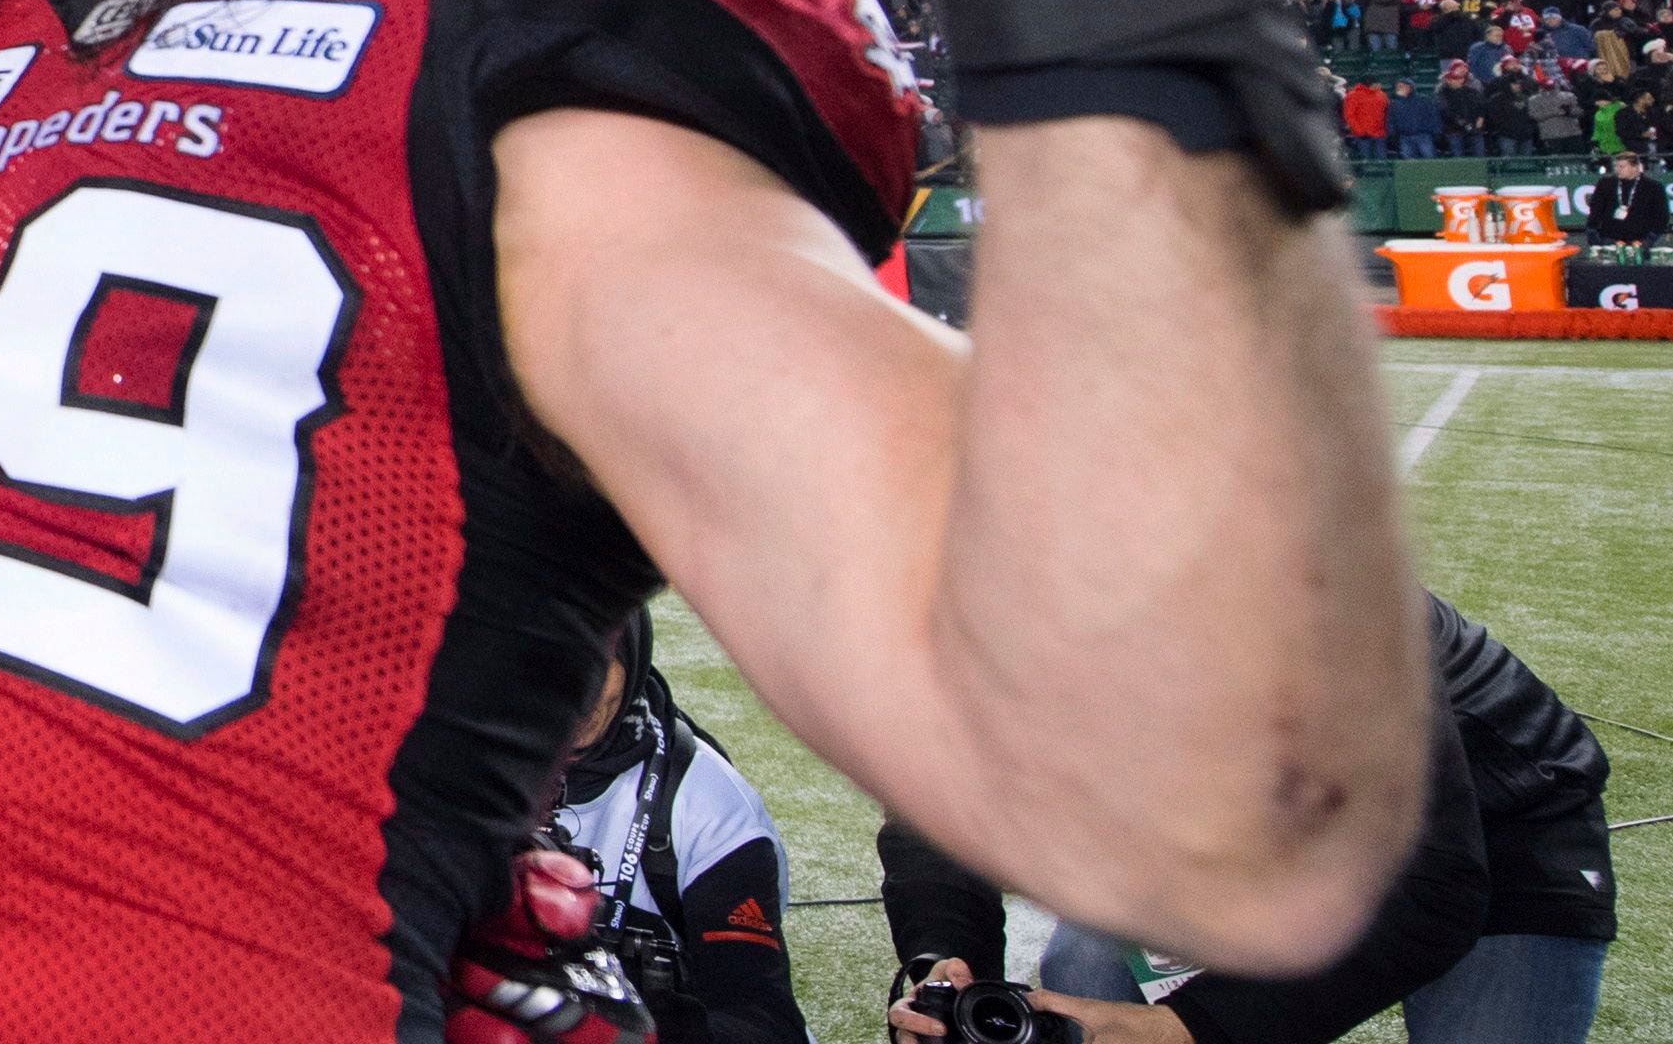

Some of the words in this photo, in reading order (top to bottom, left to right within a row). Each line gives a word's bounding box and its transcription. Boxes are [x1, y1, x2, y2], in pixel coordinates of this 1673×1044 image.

[187, 23, 260, 55] Sun
[269, 26, 349, 61] Life
[1448, 260, 1512, 311] G
[1599, 284, 1639, 311] G
[626, 822, 640, 850] COUPE
[640, 813, 650, 831] CUP
[634, 827, 647, 853] GREY
[619, 852, 638, 883] 106
